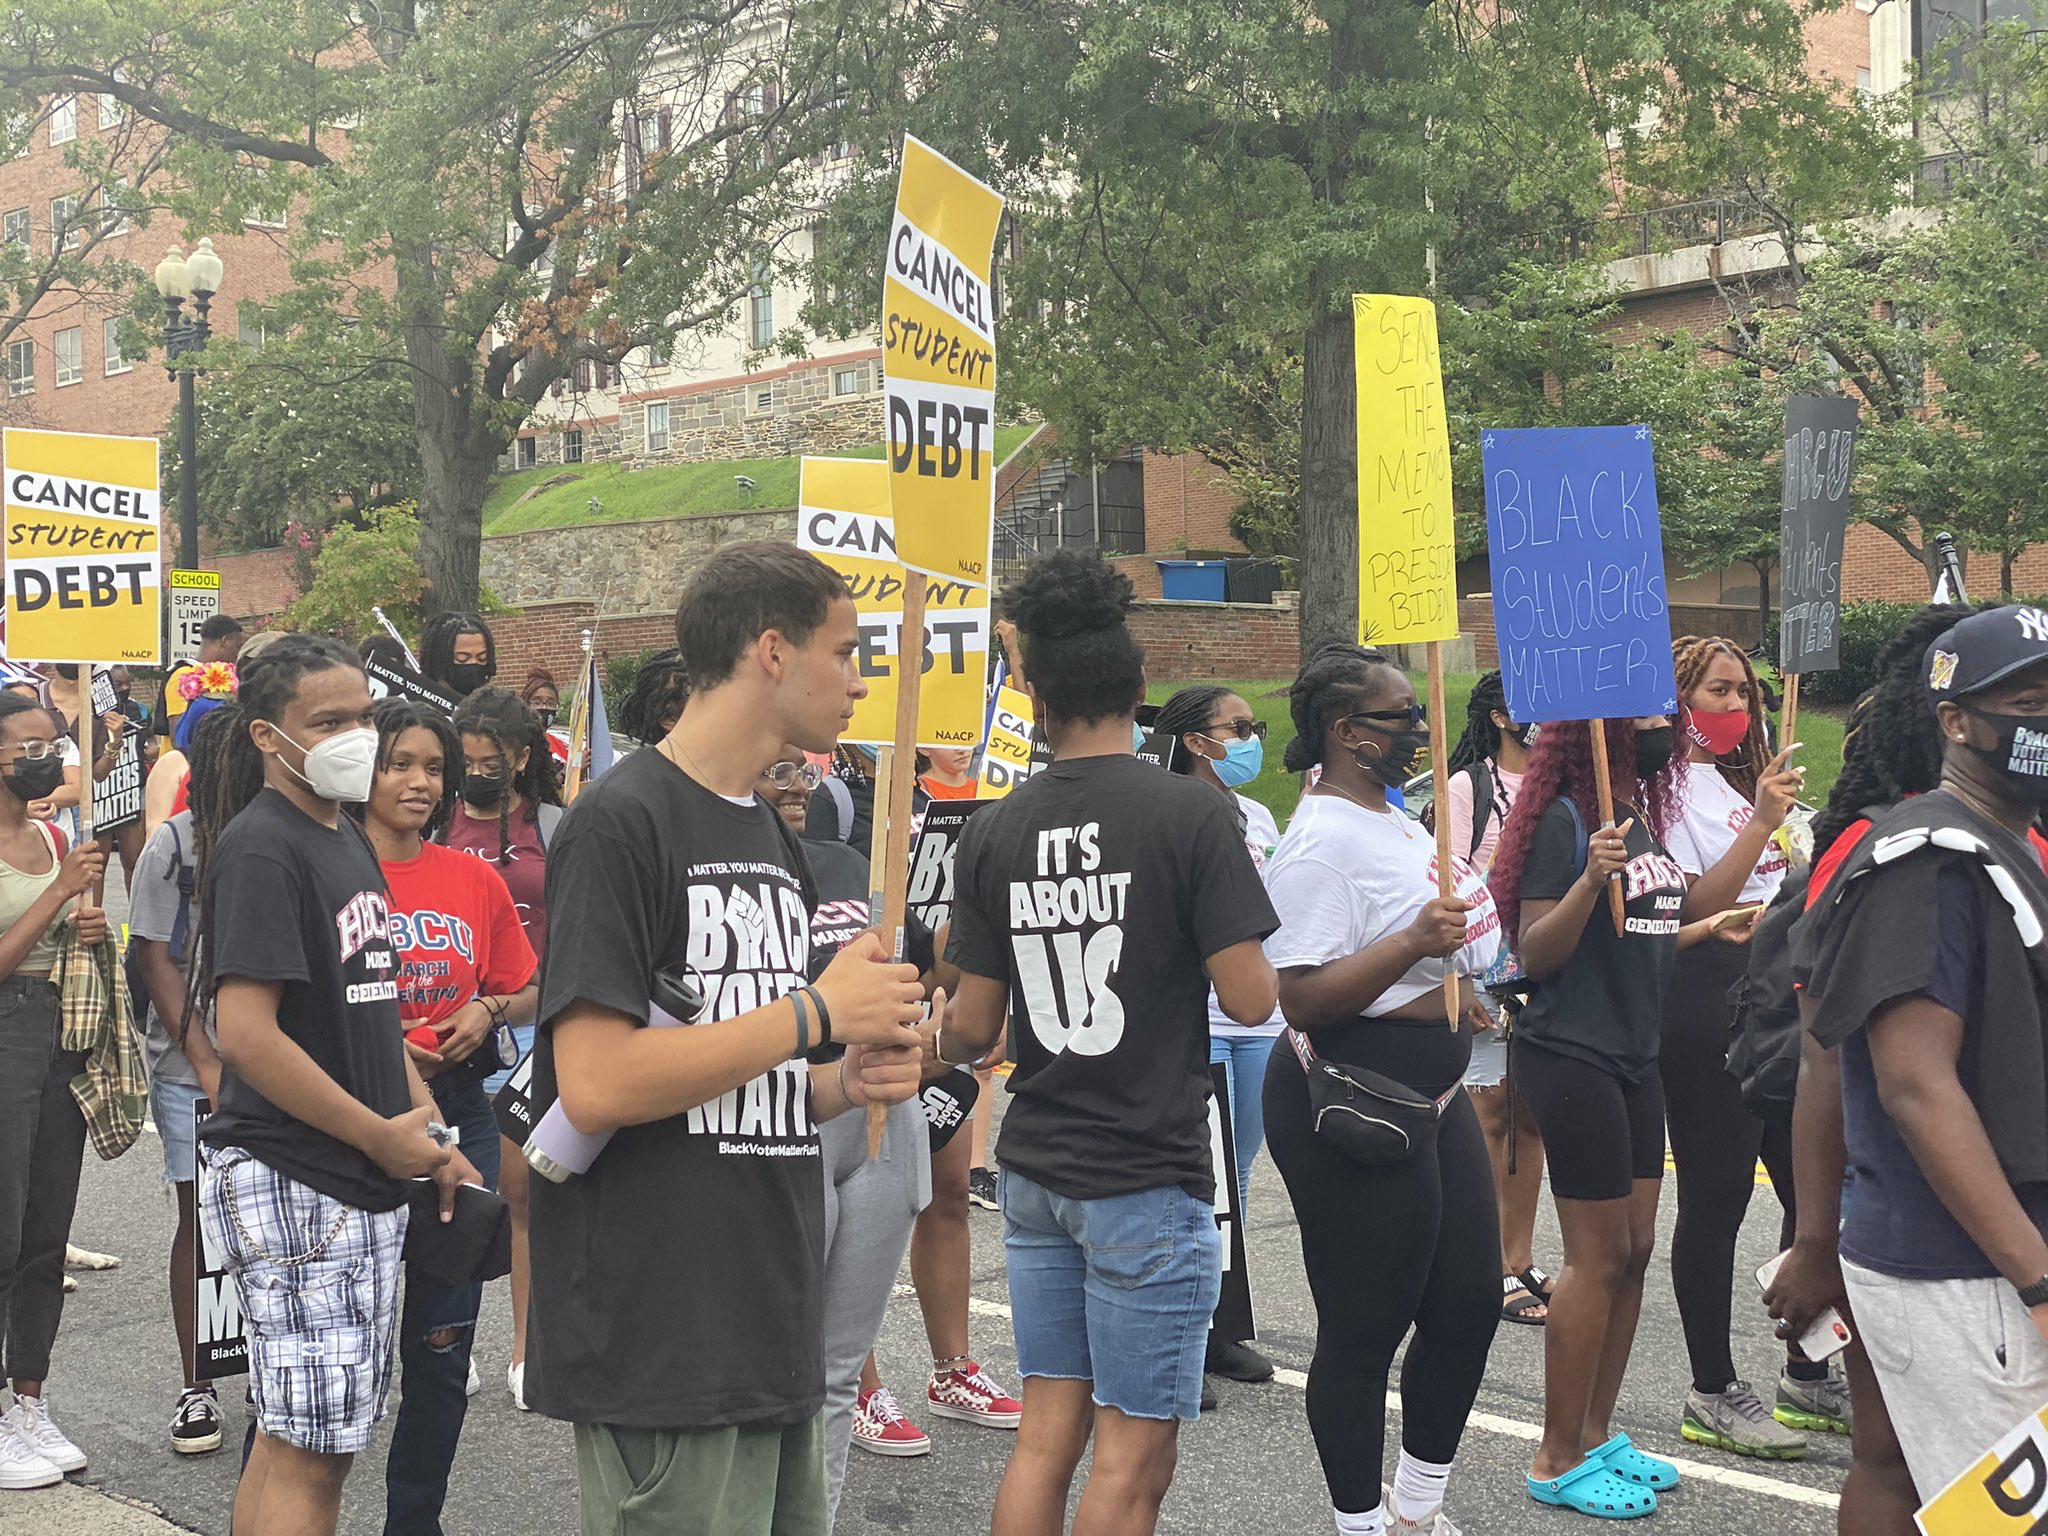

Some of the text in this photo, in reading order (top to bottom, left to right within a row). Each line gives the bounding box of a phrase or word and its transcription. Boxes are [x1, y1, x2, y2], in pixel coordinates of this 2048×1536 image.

[894, 223, 989, 334] CANCEL
[886, 312, 993, 385] STUDENT
[1396, 381, 1437, 443] THE
[890, 395, 989, 481] DEBT
[1378, 445, 1445, 504] MEMO
[1784, 427, 1852, 512] HBCU
[11, 473, 150, 520] CANCEL
[1494, 468, 1643, 554] BLACK
[8, 523, 155, 550] STUDENT
[1402, 502, 1436, 542] TO
[13, 562, 152, 612] DEBT
[174, 574, 218, 586] SCHOOL
[958, 559, 982, 576] NAACP
[174, 595, 216, 607] SPEED
[178, 609, 211, 620] LIMIT
[180, 622, 202, 645] 15
[121, 650, 152, 659] NAACP
[373, 664, 404, 686] MATTER.
[406, 680, 422, 693] YOU
[422, 689, 453, 711] MATTER.
[1507, 639, 1658, 713] MATTER
[935, 730, 975, 742] NAACP
[93, 786, 141, 827] MATTER
[931, 815, 963, 826] MATTER.
[729, 862, 749, 874] YOU
[1037, 822, 1102, 877] IT'S
[1009, 872, 1132, 929] ABOUT
[388, 909, 474, 965] BCU
[811, 926, 862, 948] MARC
[398, 960, 451, 977] ARCH
[417, 975, 434, 987] the
[1011, 924, 1126, 1056] US
[934, 1096, 959, 1129] ABOUT
